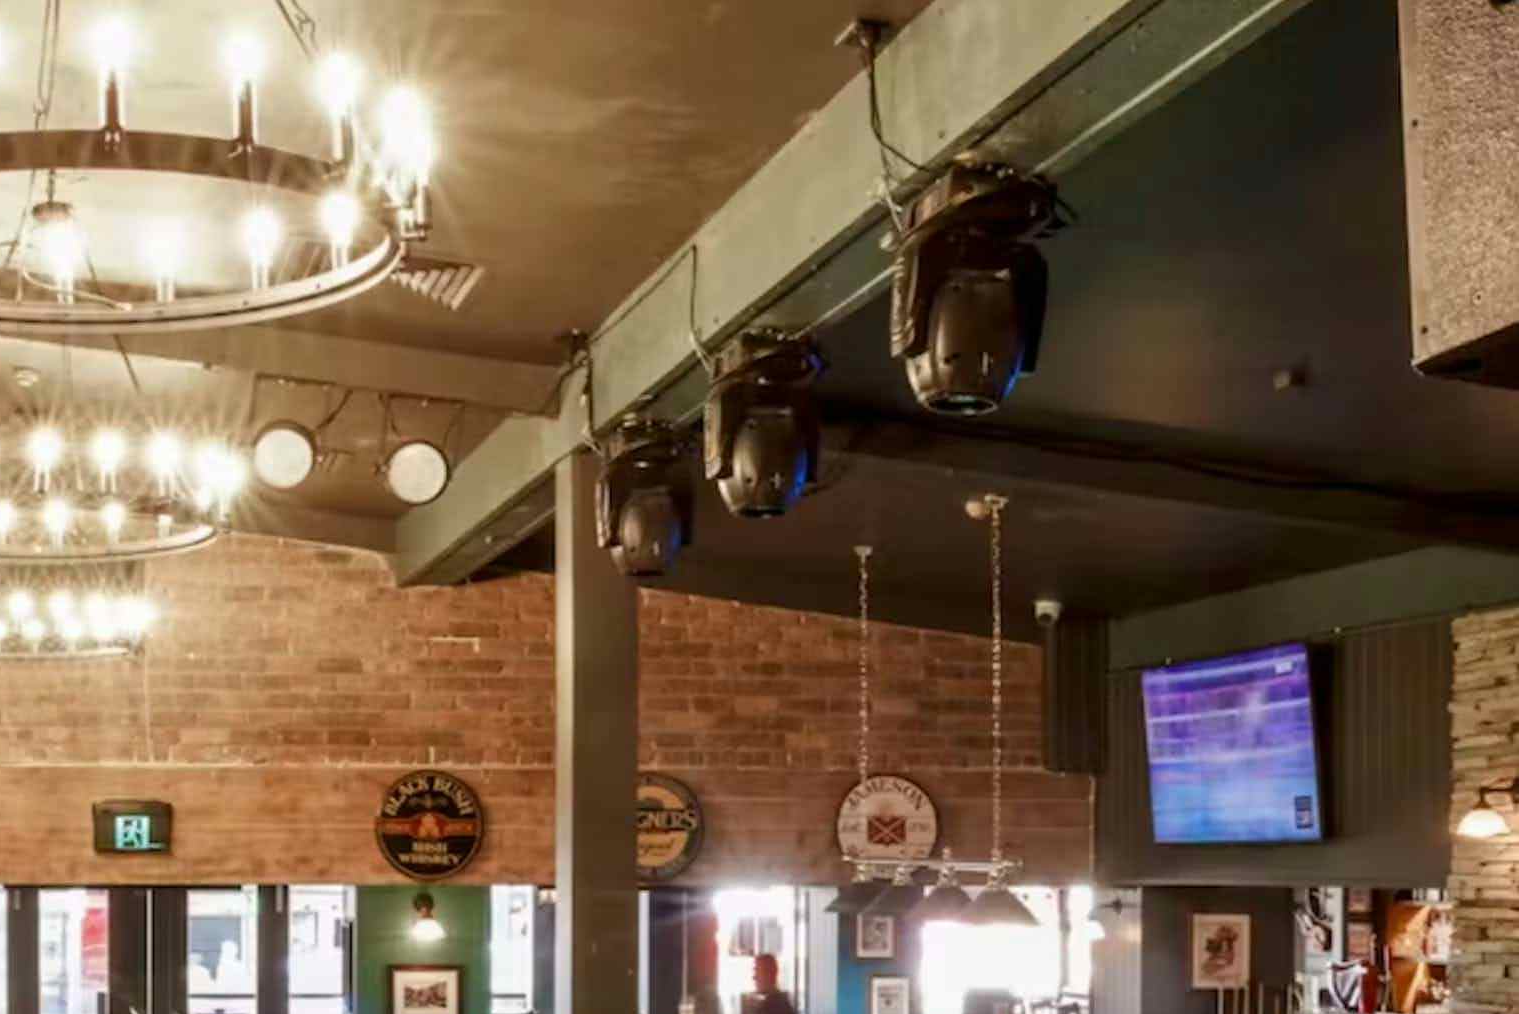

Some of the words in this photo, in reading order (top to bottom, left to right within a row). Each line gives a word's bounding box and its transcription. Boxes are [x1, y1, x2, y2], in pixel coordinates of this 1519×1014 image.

[384, 776, 430, 817] BLACK
[433, 776, 474, 817] BUSH
[847, 778, 925, 811] JAMESON
